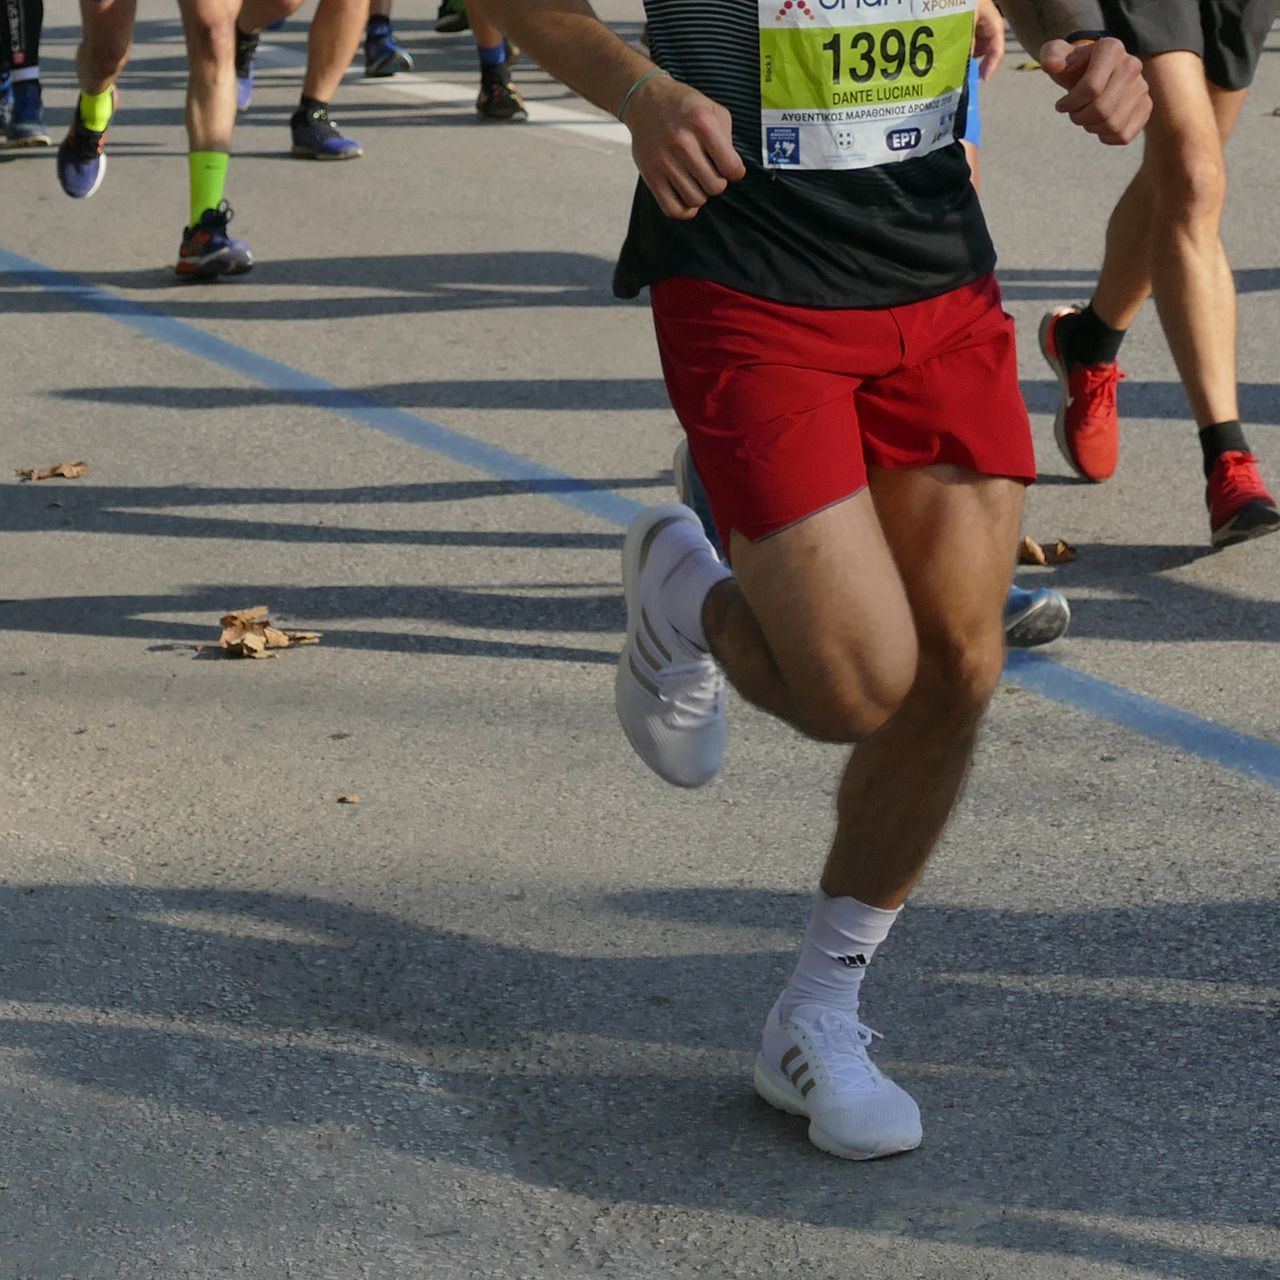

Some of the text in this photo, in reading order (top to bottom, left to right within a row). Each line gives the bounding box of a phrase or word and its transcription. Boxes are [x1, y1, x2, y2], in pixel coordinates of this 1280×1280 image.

[822, 25, 935, 86] 1396
[832, 83, 924, 106] DANTE LUCIANI
[781, 111, 844, 123] ΑΥΘΕΝΤΙΚΟΣ
[845, 104, 907, 120] ΜΑΡΑΘΩΝΙΟΣ
[907, 100, 940, 114] ΔΡΟΜΟΣ
[892, 130, 917, 148] ΕΡΤ
